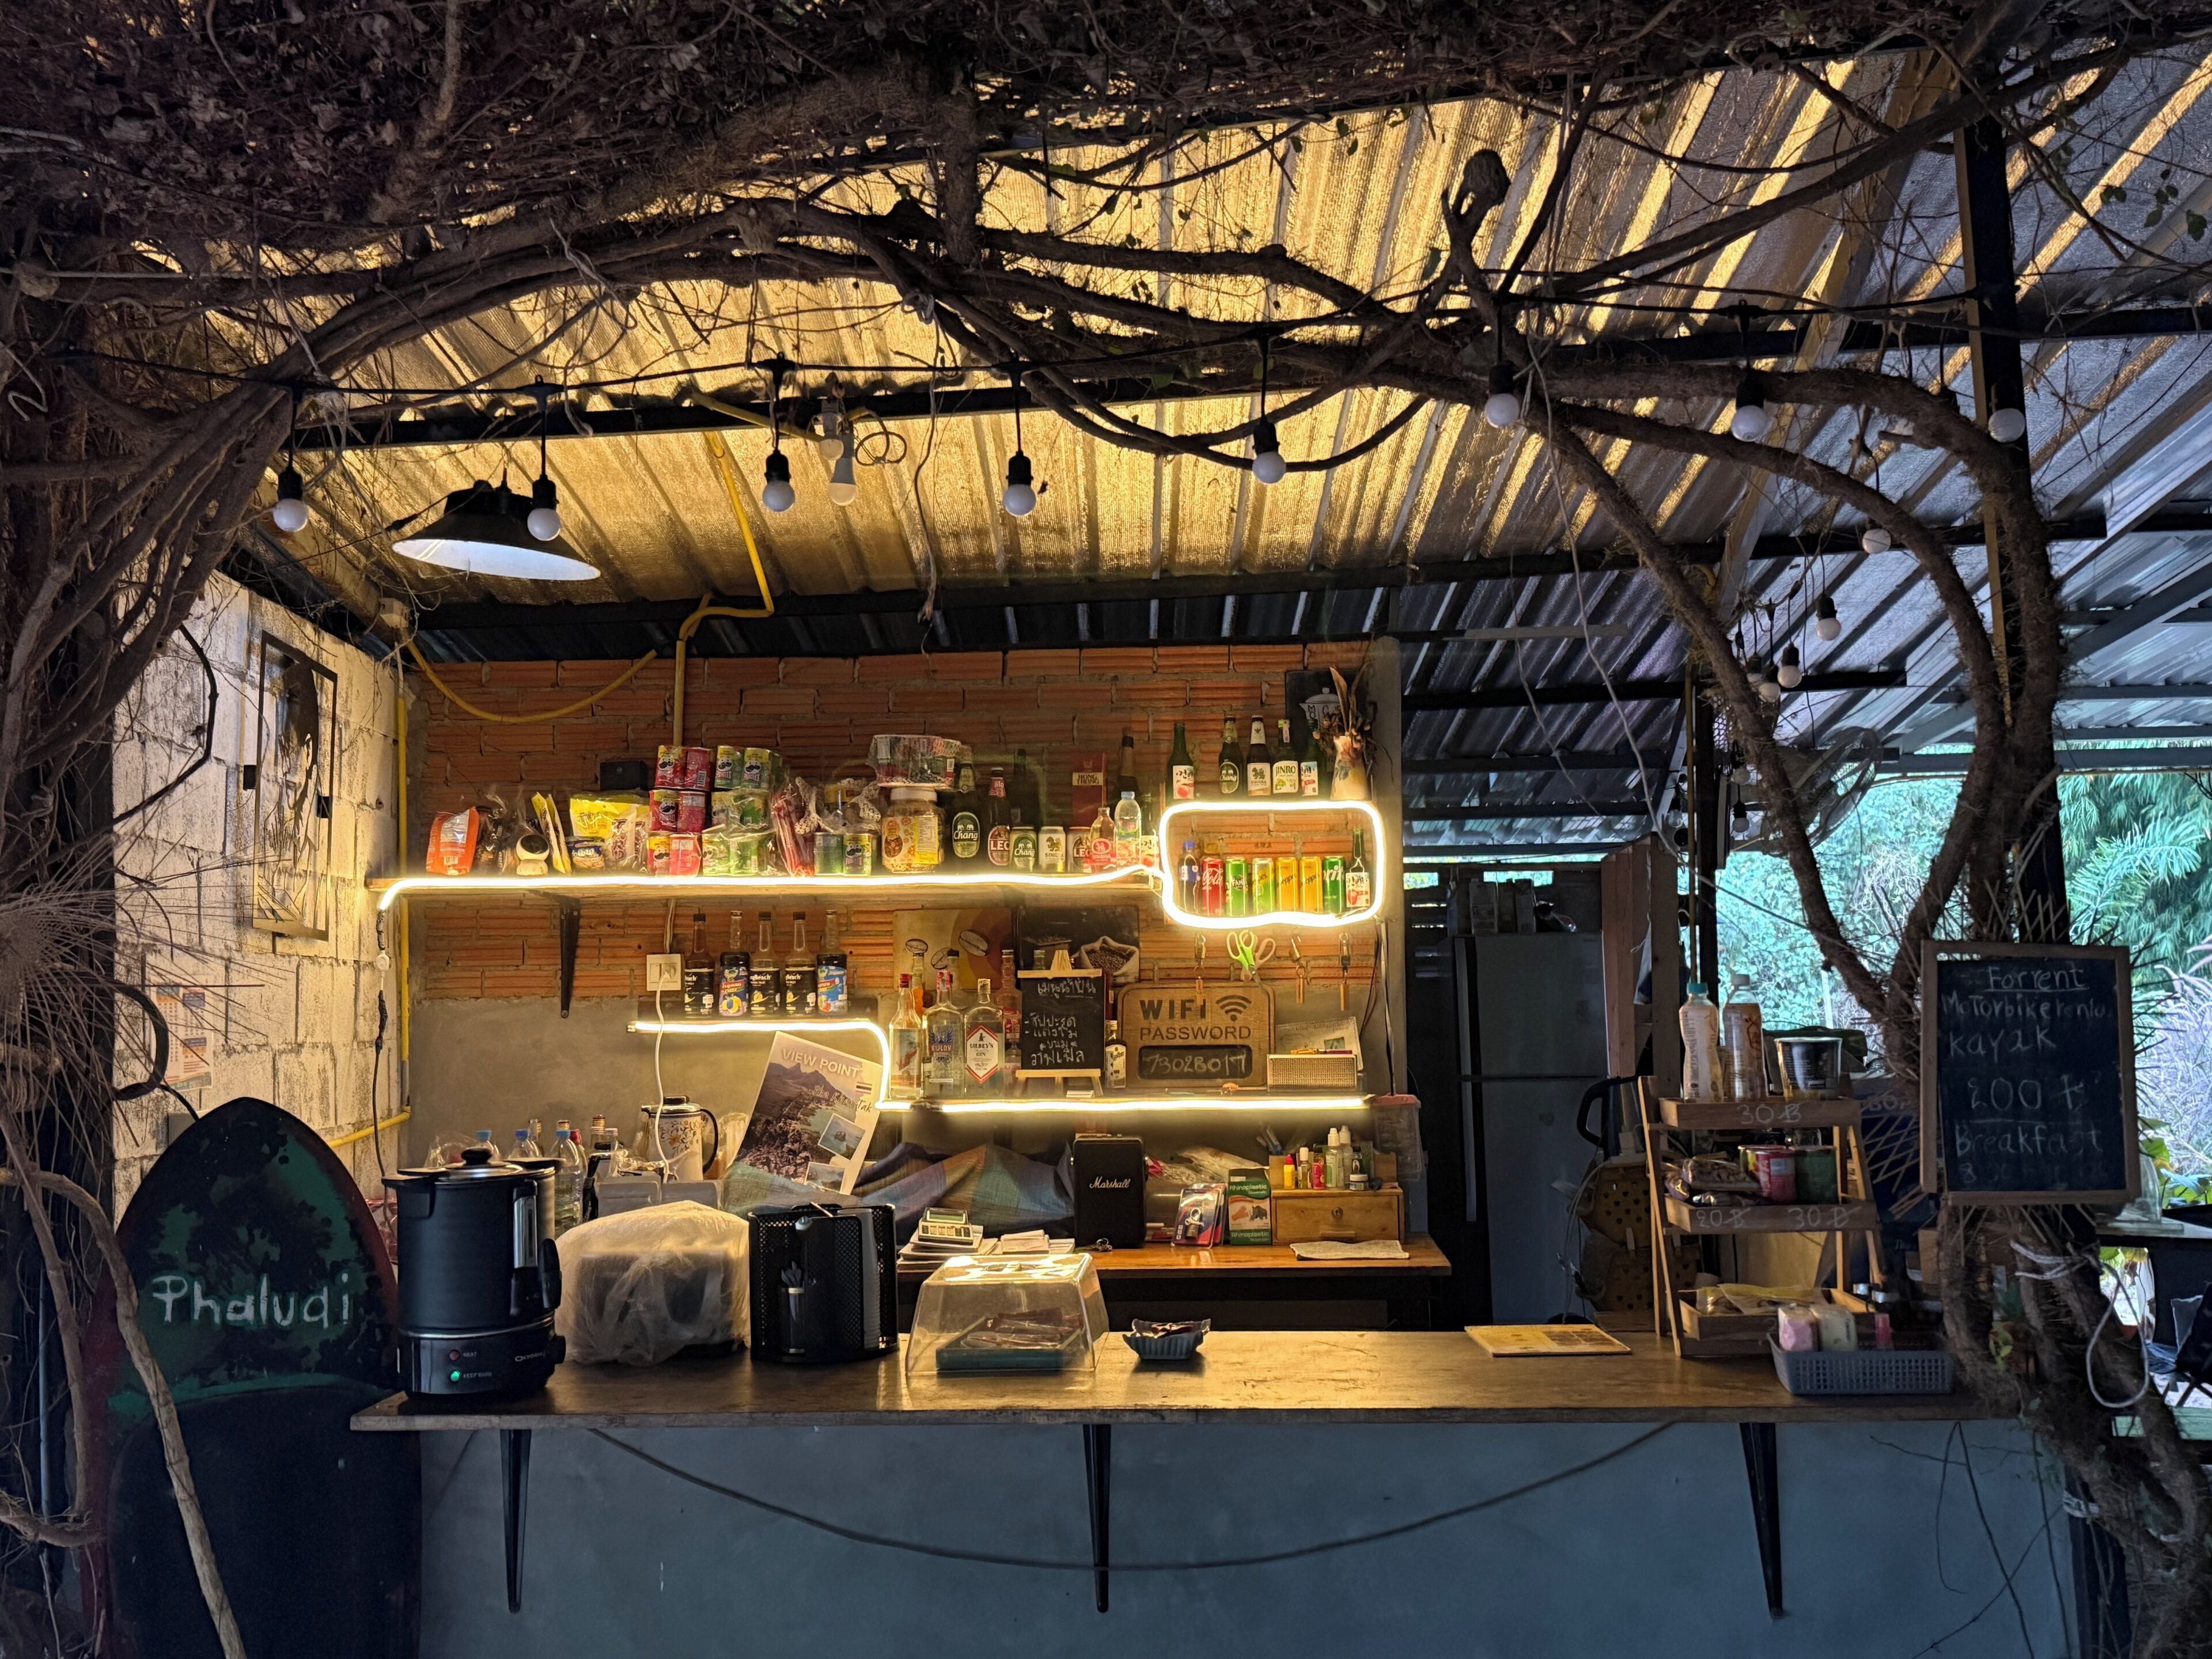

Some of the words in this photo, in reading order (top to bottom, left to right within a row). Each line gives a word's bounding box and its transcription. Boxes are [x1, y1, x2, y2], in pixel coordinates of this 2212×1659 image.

[1275, 766, 1296, 777] JINRO
[953, 830, 978, 840] Chang
[1014, 848, 1035, 857] Chang
[1139, 998, 1207, 1020] WIFI
[1140, 1026, 1251, 1040] PASSWORD
[782, 1048, 817, 1066] VIEW
[819, 1058, 860, 1078] POINT
[1089, 1176, 1131, 1190] Marshall
[1229, 1184, 1267, 1192] Rhinoplastic
